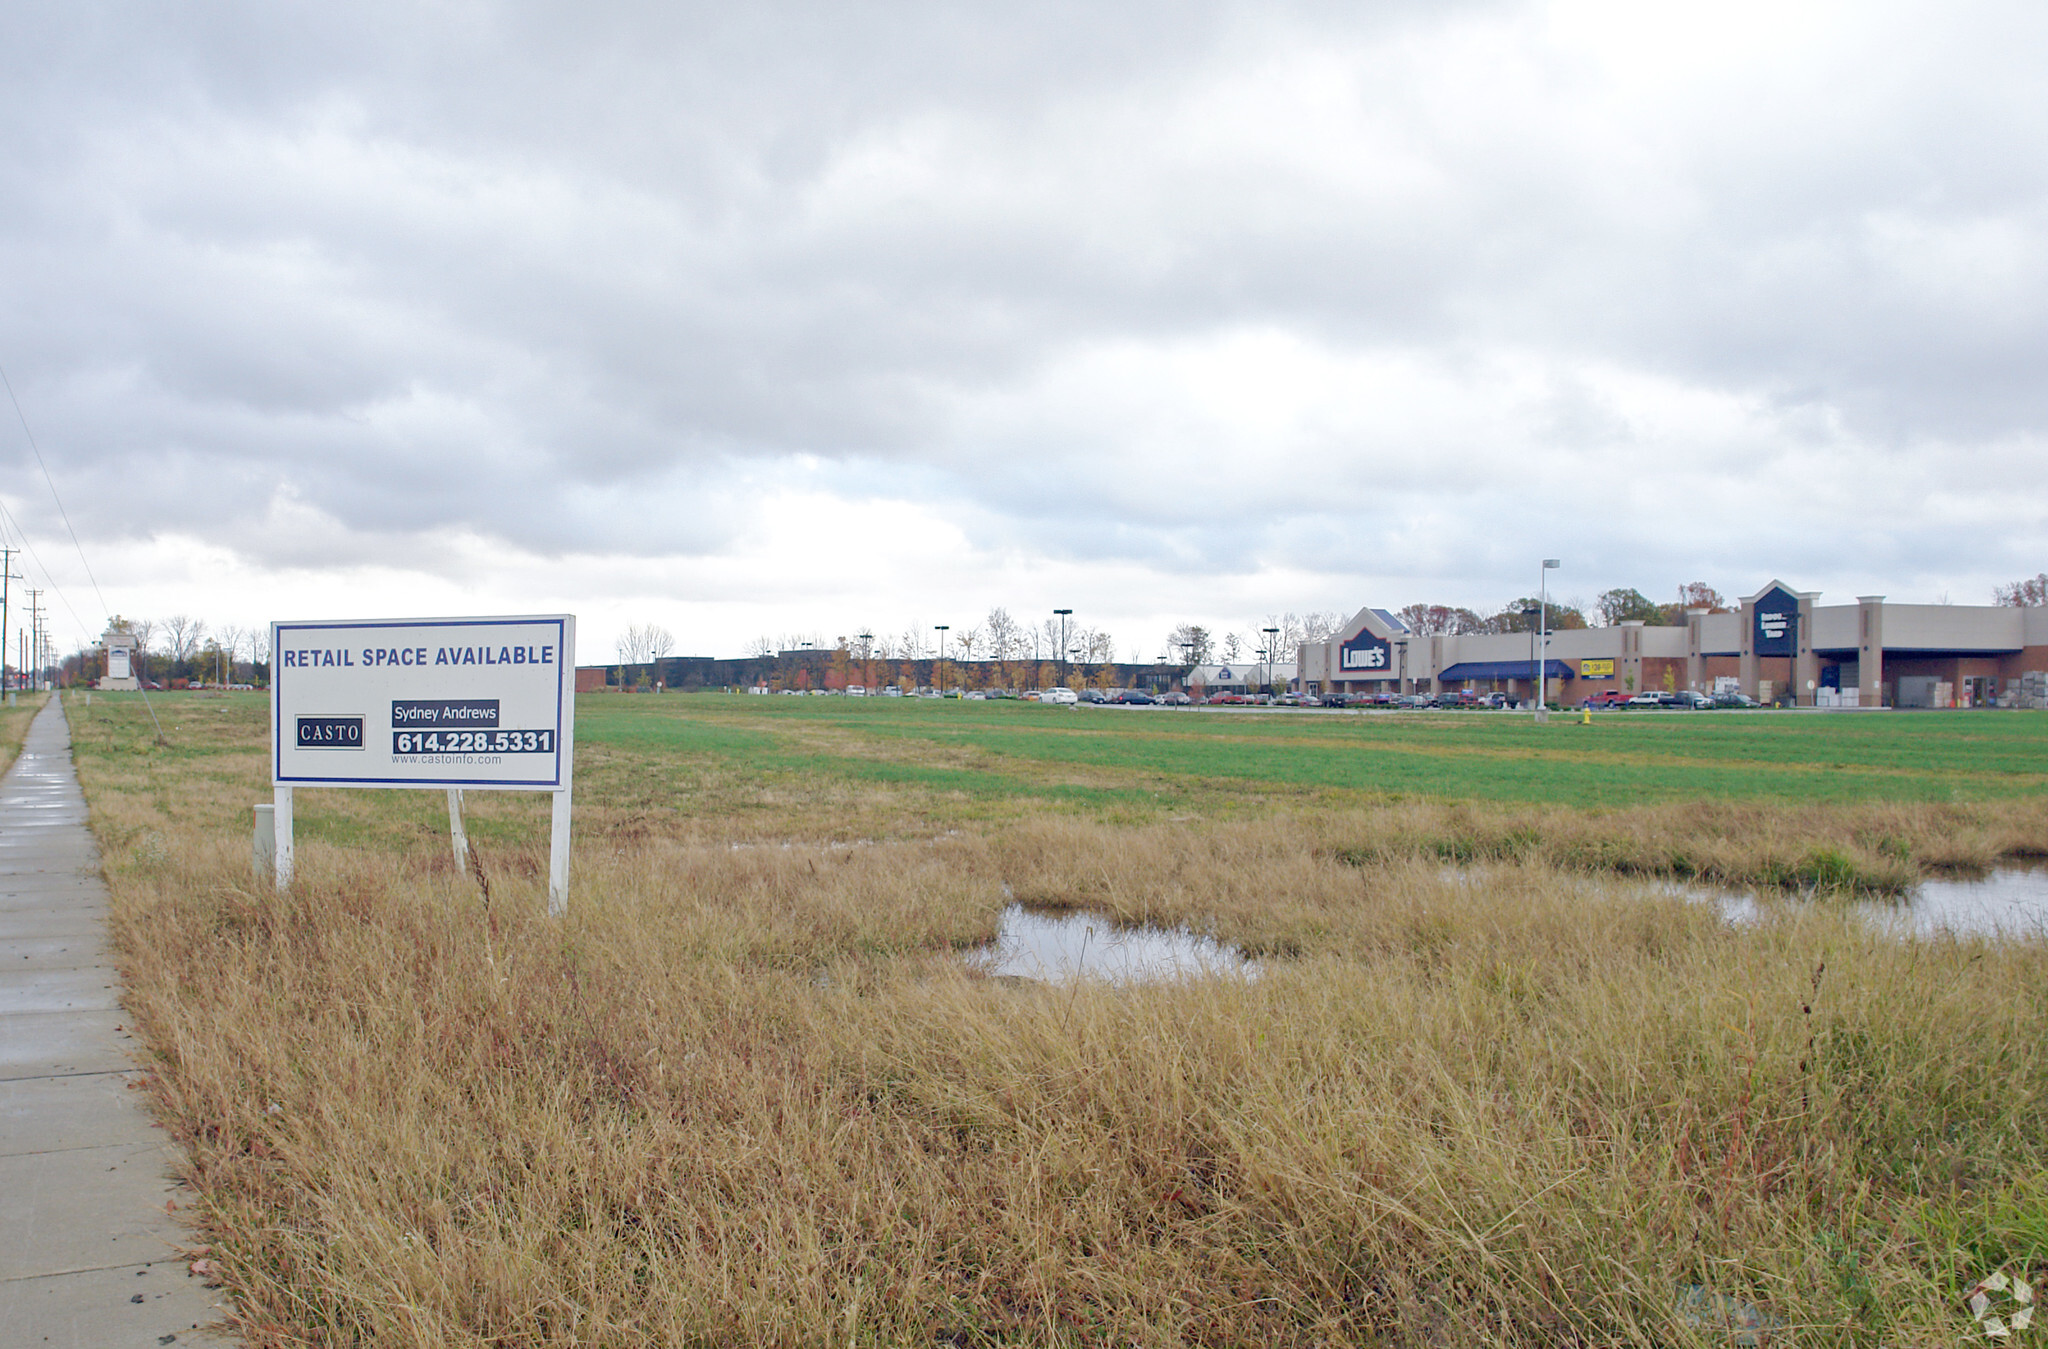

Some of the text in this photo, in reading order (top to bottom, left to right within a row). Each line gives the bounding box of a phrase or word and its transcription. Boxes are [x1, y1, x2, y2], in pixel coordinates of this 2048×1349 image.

[284, 645, 554, 667] RETAIL SPACE AVAILABLE
[394, 706, 497, 722] Sydney Andrews
[300, 724, 359, 741] CASTO
[397, 731, 551, 753] 614.228.5331
[391, 753, 502, 765] www.castoinfo.com
